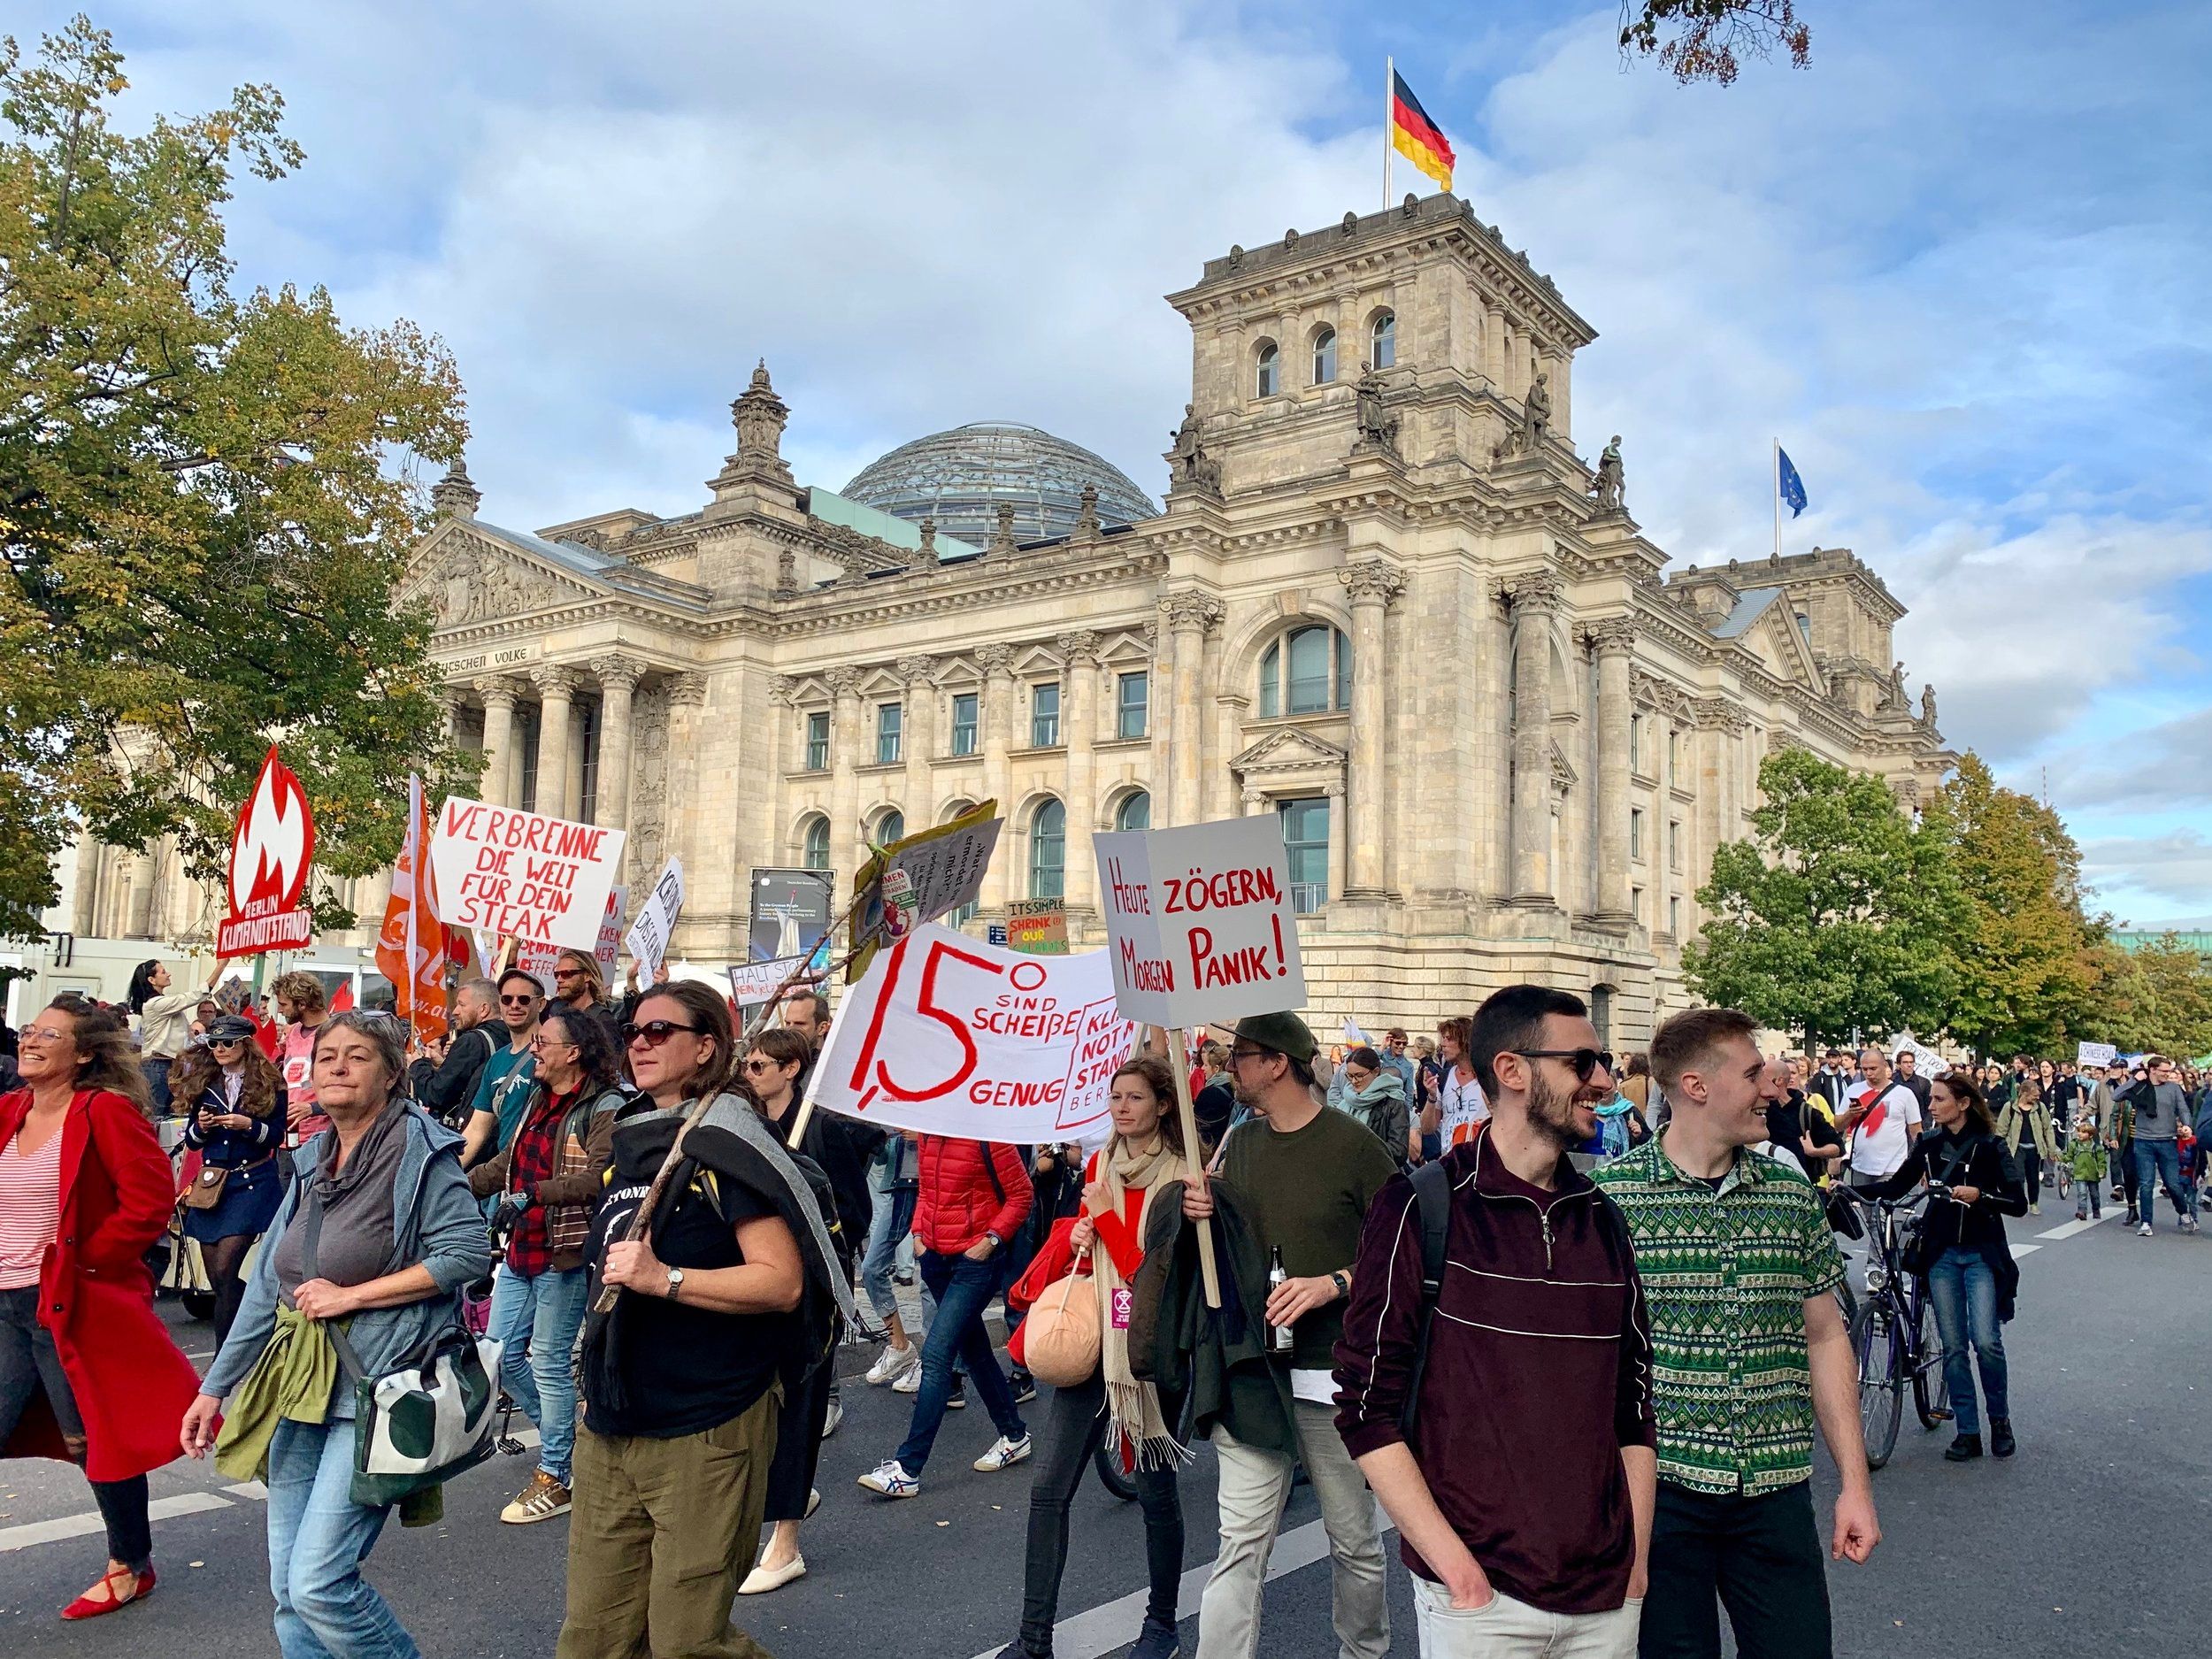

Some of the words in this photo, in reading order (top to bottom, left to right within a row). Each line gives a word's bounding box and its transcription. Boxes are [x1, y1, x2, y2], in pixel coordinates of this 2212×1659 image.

[442, 656, 487, 672] UTSCHEN
[495, 649, 527, 664] VOLKE
[447, 802, 609, 863] VERBRENNE
[475, 847, 515, 876] DIE
[526, 856, 580, 889] WELT
[955, 834, 973, 887] ermordet
[460, 873, 511, 902] FÜR
[517, 883, 572, 913] DEIN
[1163, 866, 1283, 914] ZÖGERN,
[245, 894, 279, 919] BERLIN
[457, 897, 557, 940] STEAK
[1009, 902, 1033, 916] IT'S
[1033, 898, 1065, 914] SIMPLE
[220, 910, 311, 952] KLIMANOTSTAND
[1010, 917, 1051, 933] SHRINK
[1021, 929, 1046, 941] OUR
[1187, 912, 1287, 990] PANIK!
[733, 964, 770, 986] HALT
[996, 994, 1057, 1011] SIND
[1087, 1007, 1119, 1035] KLI
[1074, 1043, 1131, 1090] STAND
[969, 1079, 1065, 1107] GENUG
[1070, 1082, 1112, 1111] BERL
[1445, 1098, 1478, 1115] LIFE
